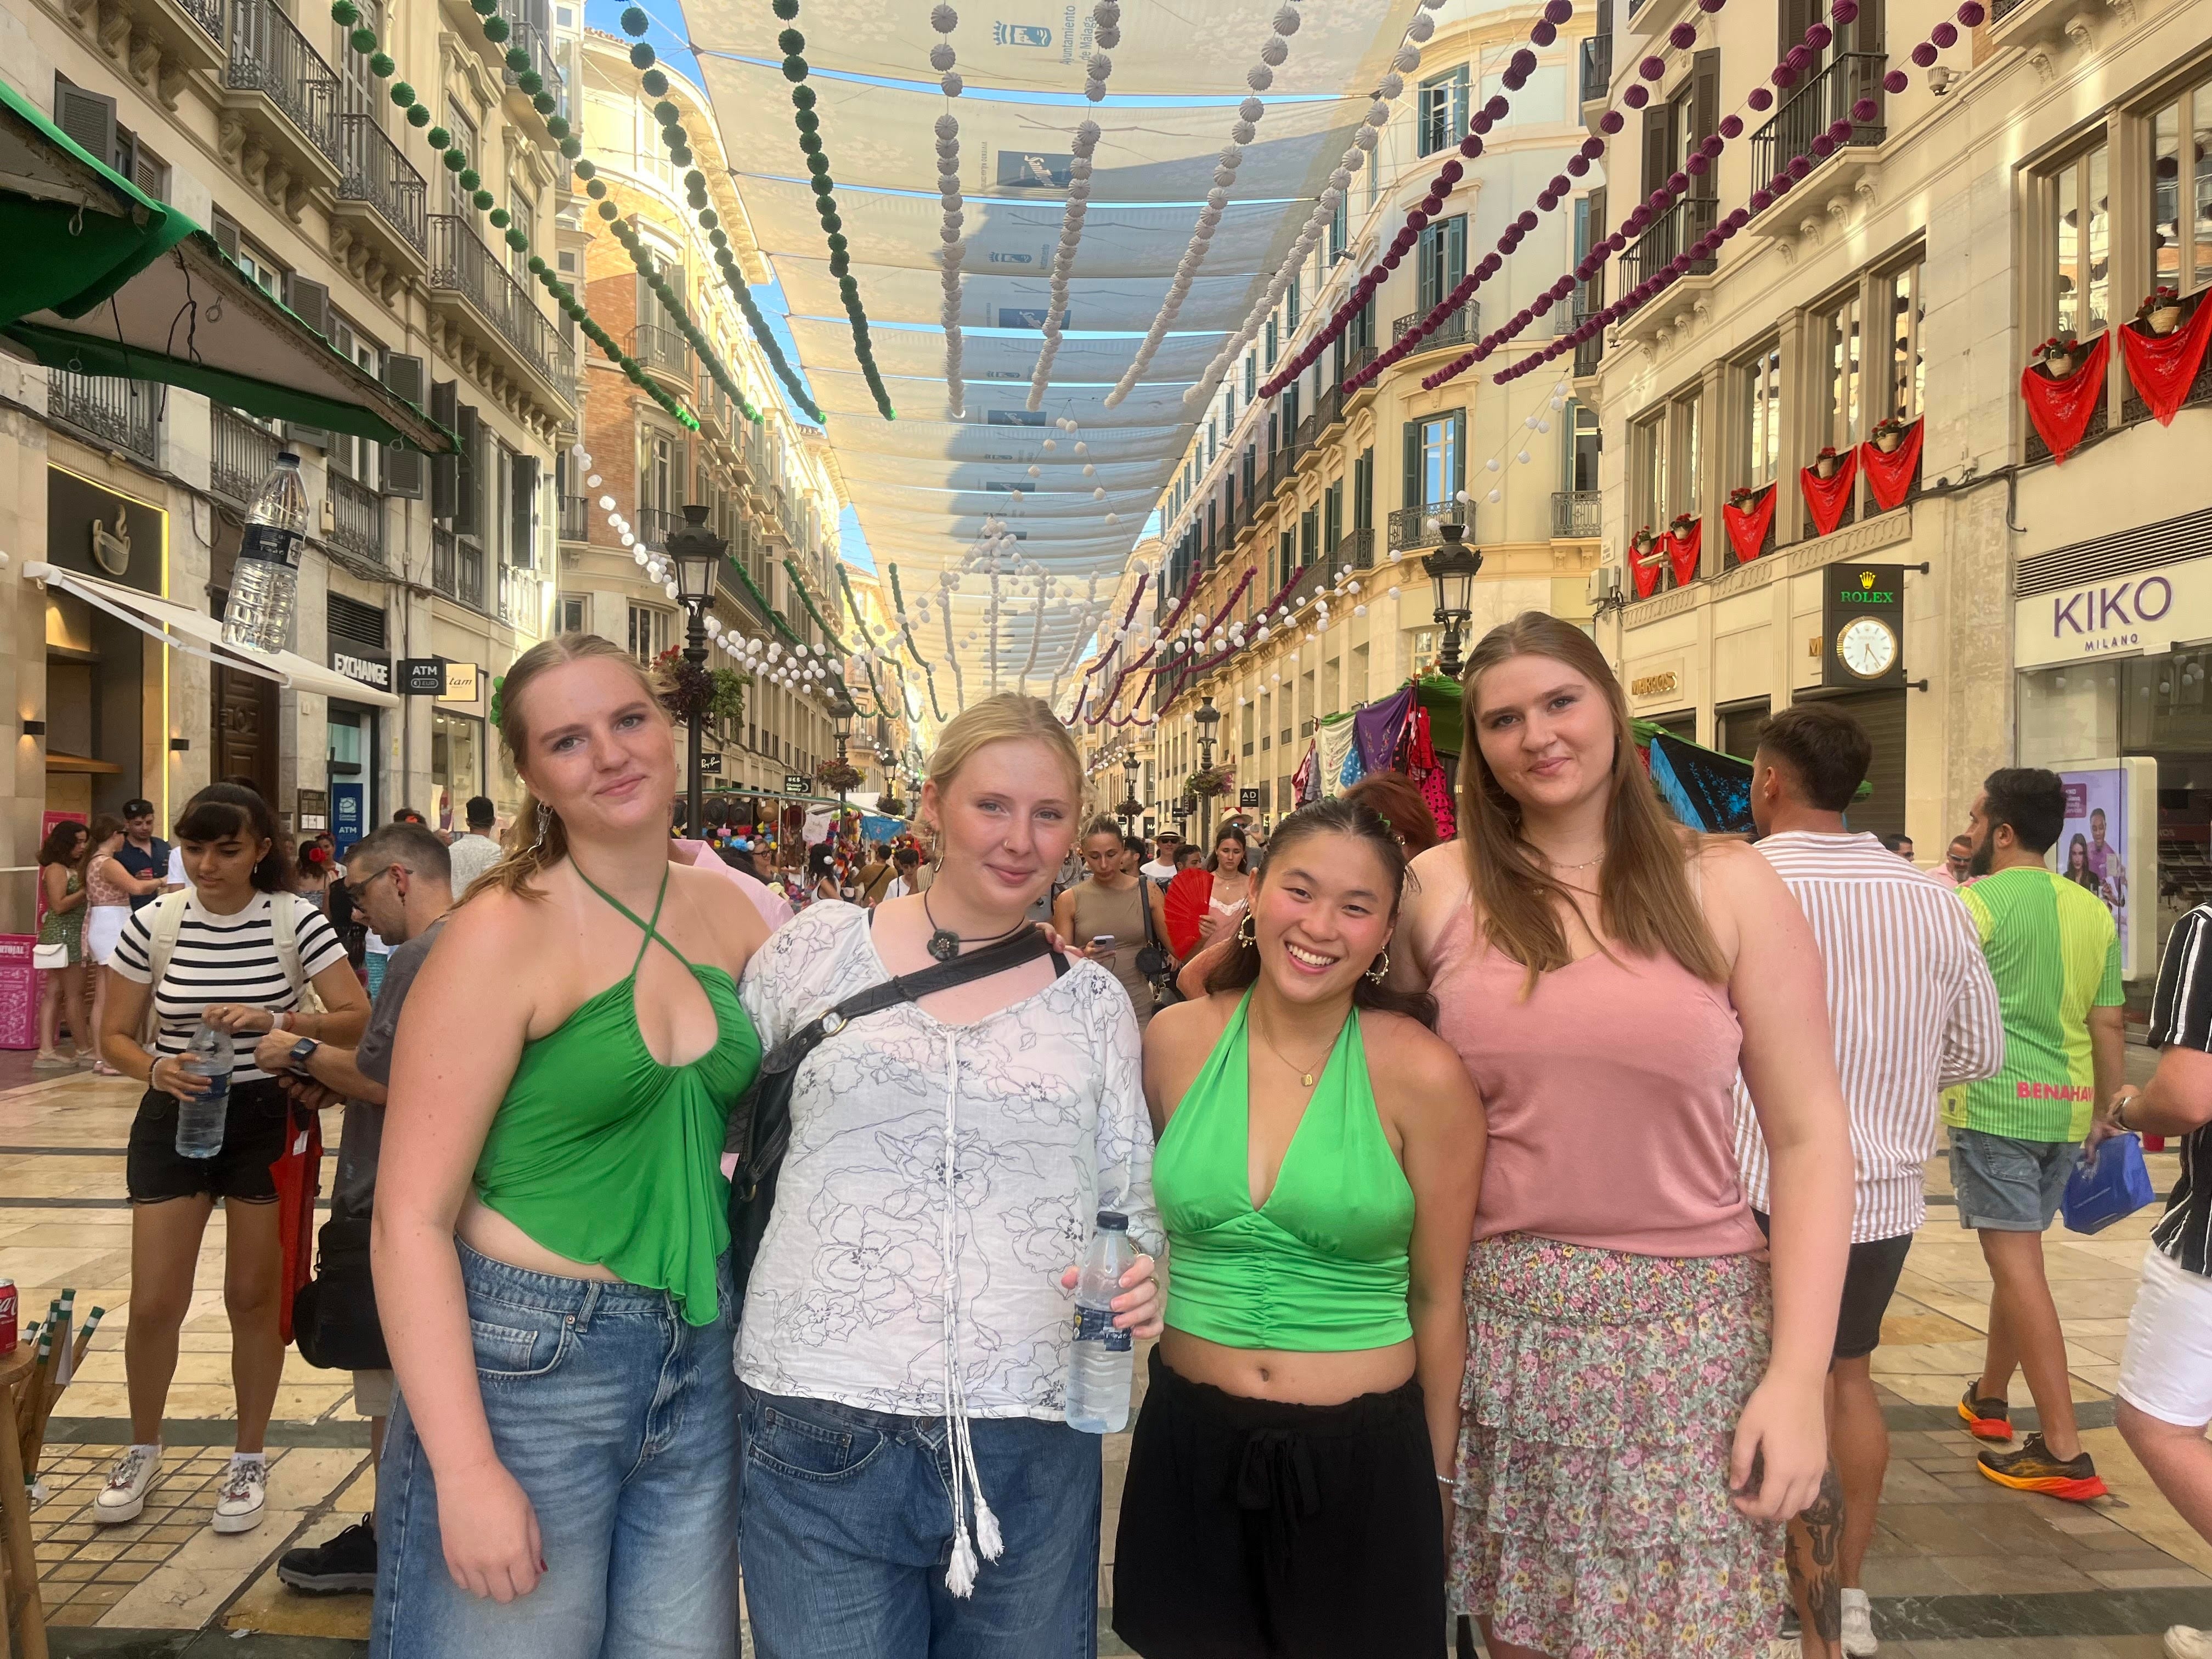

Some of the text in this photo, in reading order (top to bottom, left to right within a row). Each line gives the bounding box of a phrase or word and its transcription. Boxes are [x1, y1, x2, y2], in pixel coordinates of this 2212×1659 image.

[1059, 5, 1076, 66] Ayuntamiento
[1079, 16, 1096, 61] de Málaga
[1841, 591, 1894, 603] ROLEX
[2053, 576, 2172, 637] KIKO
[2085, 634, 2138, 652] MILANO
[334, 653, 388, 686] EXCHANGE
[413, 665, 437, 675] ATM
[1632, 672, 1677, 695] MARCOS
